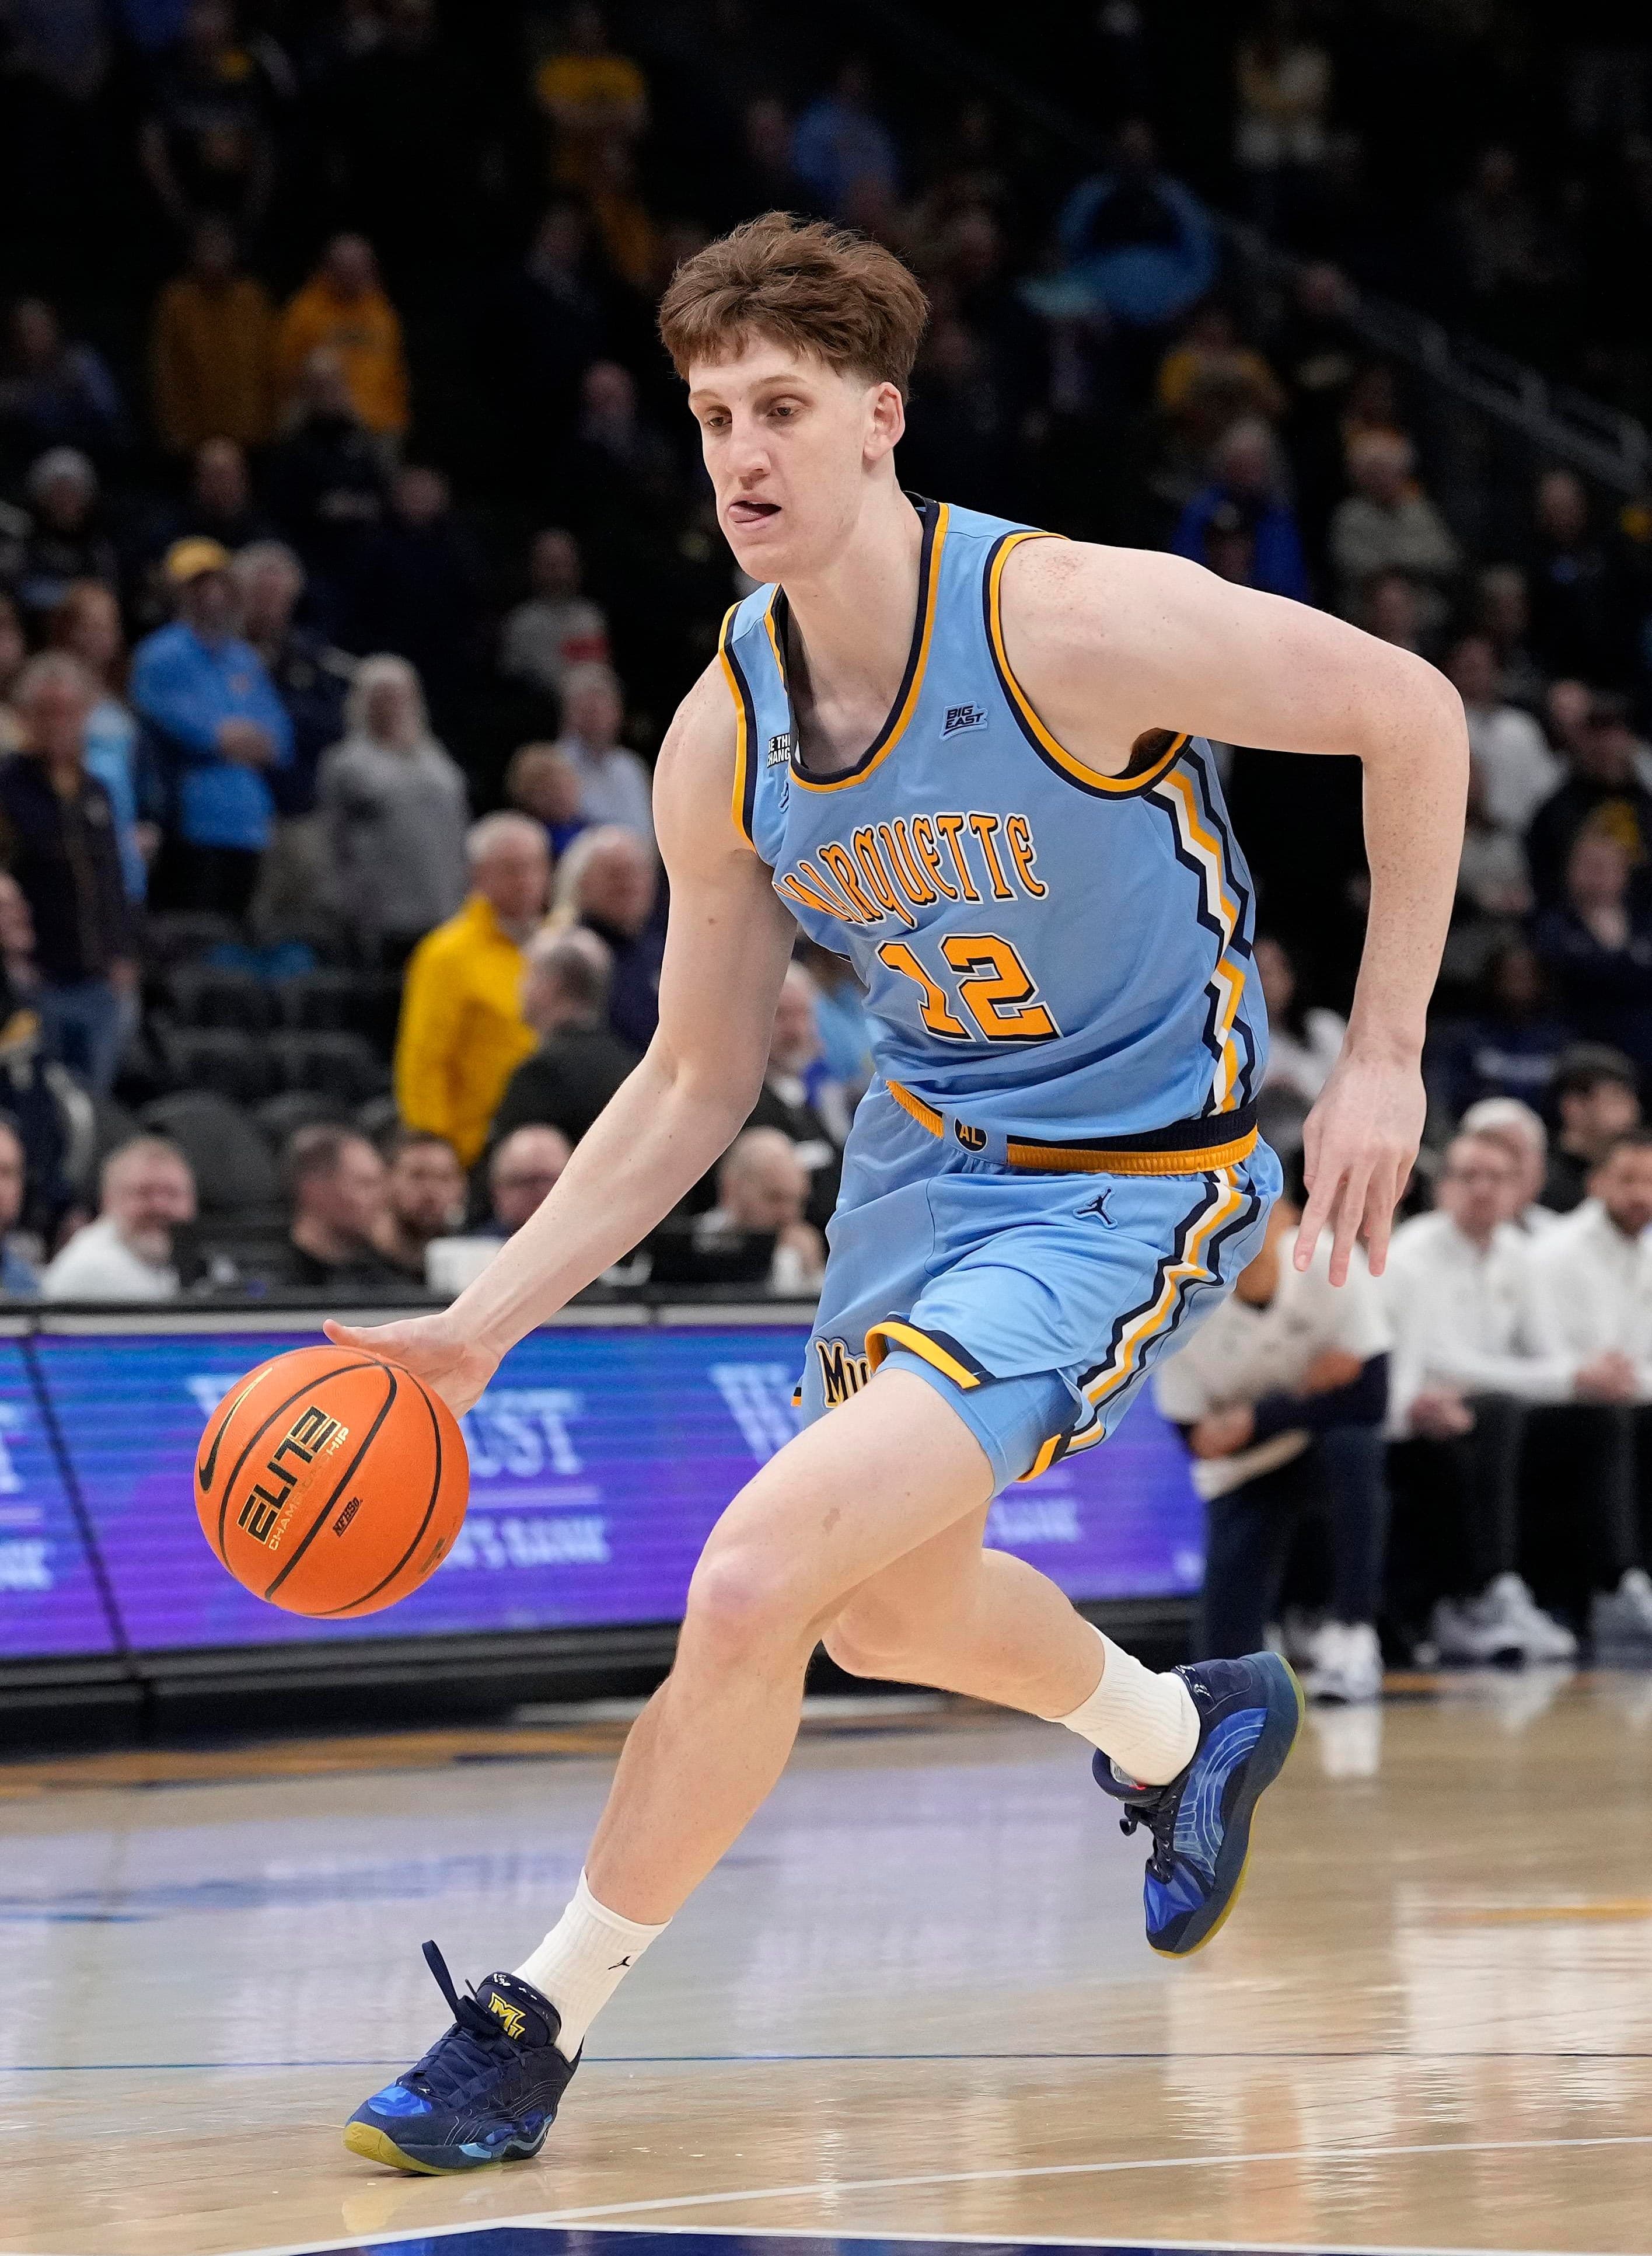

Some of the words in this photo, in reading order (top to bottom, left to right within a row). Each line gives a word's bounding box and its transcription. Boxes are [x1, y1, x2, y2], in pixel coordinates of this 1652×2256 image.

[945, 712, 985, 730] EAST
[947, 705, 974, 720] BIG
[769, 738, 775, 753] E
[767, 747, 790, 767] HANG
[875, 933, 1063, 1043] 12
[959, 1124, 983, 1146] AL
[237, 1406, 341, 1544] ELITE
[268, 1427, 349, 1550] CHAMHIP
